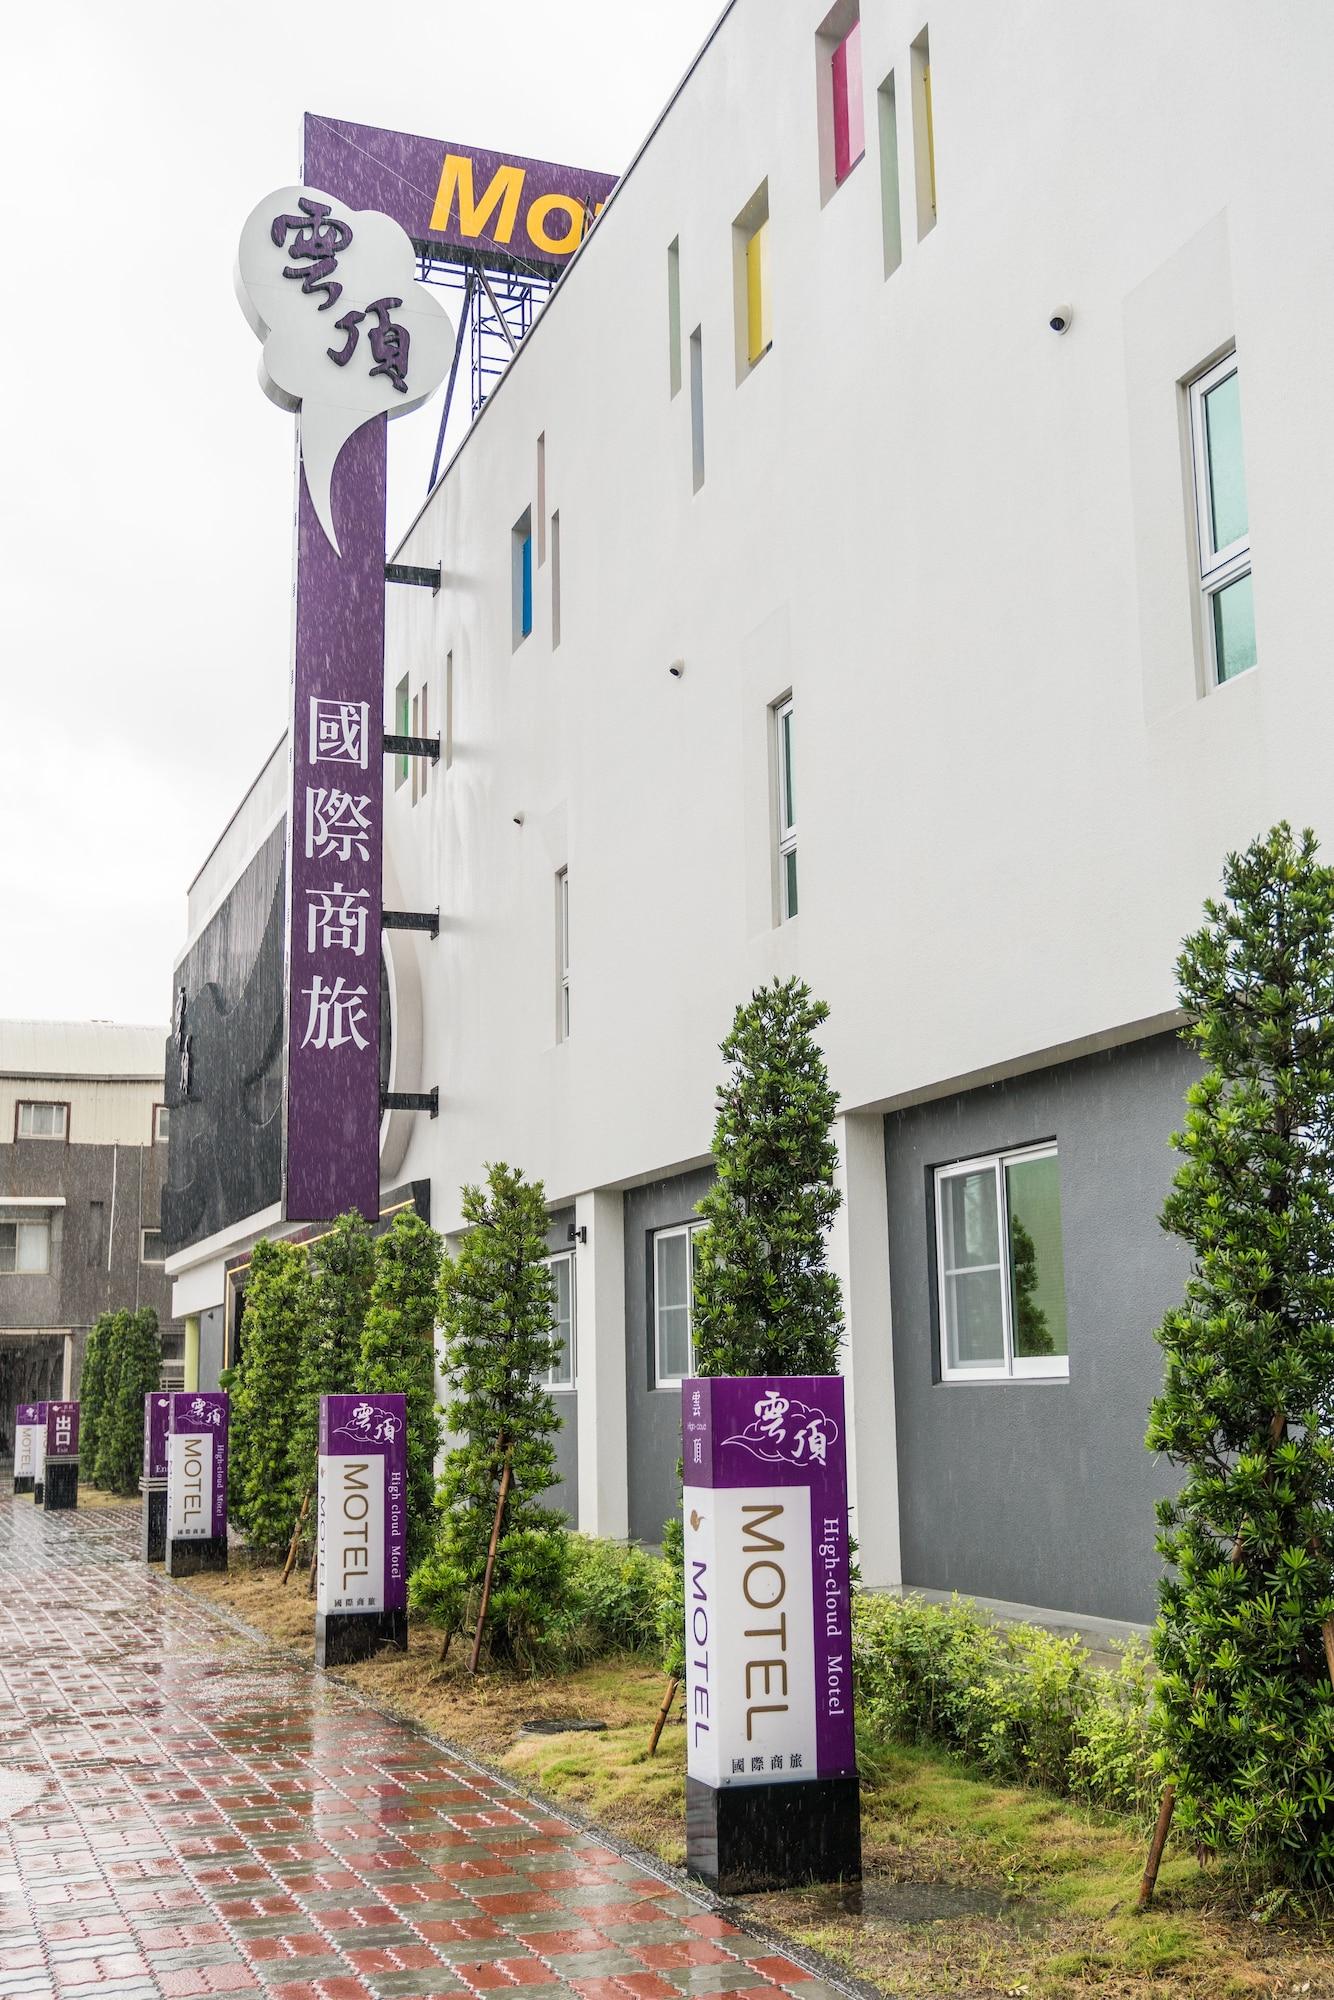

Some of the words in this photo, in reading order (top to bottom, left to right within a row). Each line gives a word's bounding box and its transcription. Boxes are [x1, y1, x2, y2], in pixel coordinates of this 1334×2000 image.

[429, 154, 606, 255] Mo
[271, 196, 411, 394] 雲頂
[301, 696, 372, 1051] 國際商旅
[56, 1415, 71, 1446] 出口
[191, 1398, 221, 1426] 雲頂
[353, 1402, 395, 1444] 雲頂
[754, 1390, 827, 1466] 雲頂
[21, 1428, 32, 1470] MOTEL
[156, 1465, 168, 1474] En
[184, 1439, 202, 1524] MOTEL
[216, 1494, 224, 1517] Motel
[344, 1464, 369, 1591] MOTEL
[391, 1545, 401, 1579] Motel
[818, 1517, 842, 1638] High-cloud
[692, 1561, 710, 1749] MOTEL
[741, 1504, 789, 1742] MOTEL
[826, 1655, 845, 1717] Motel
[732, 1753, 803, 1774] 國際商旅
